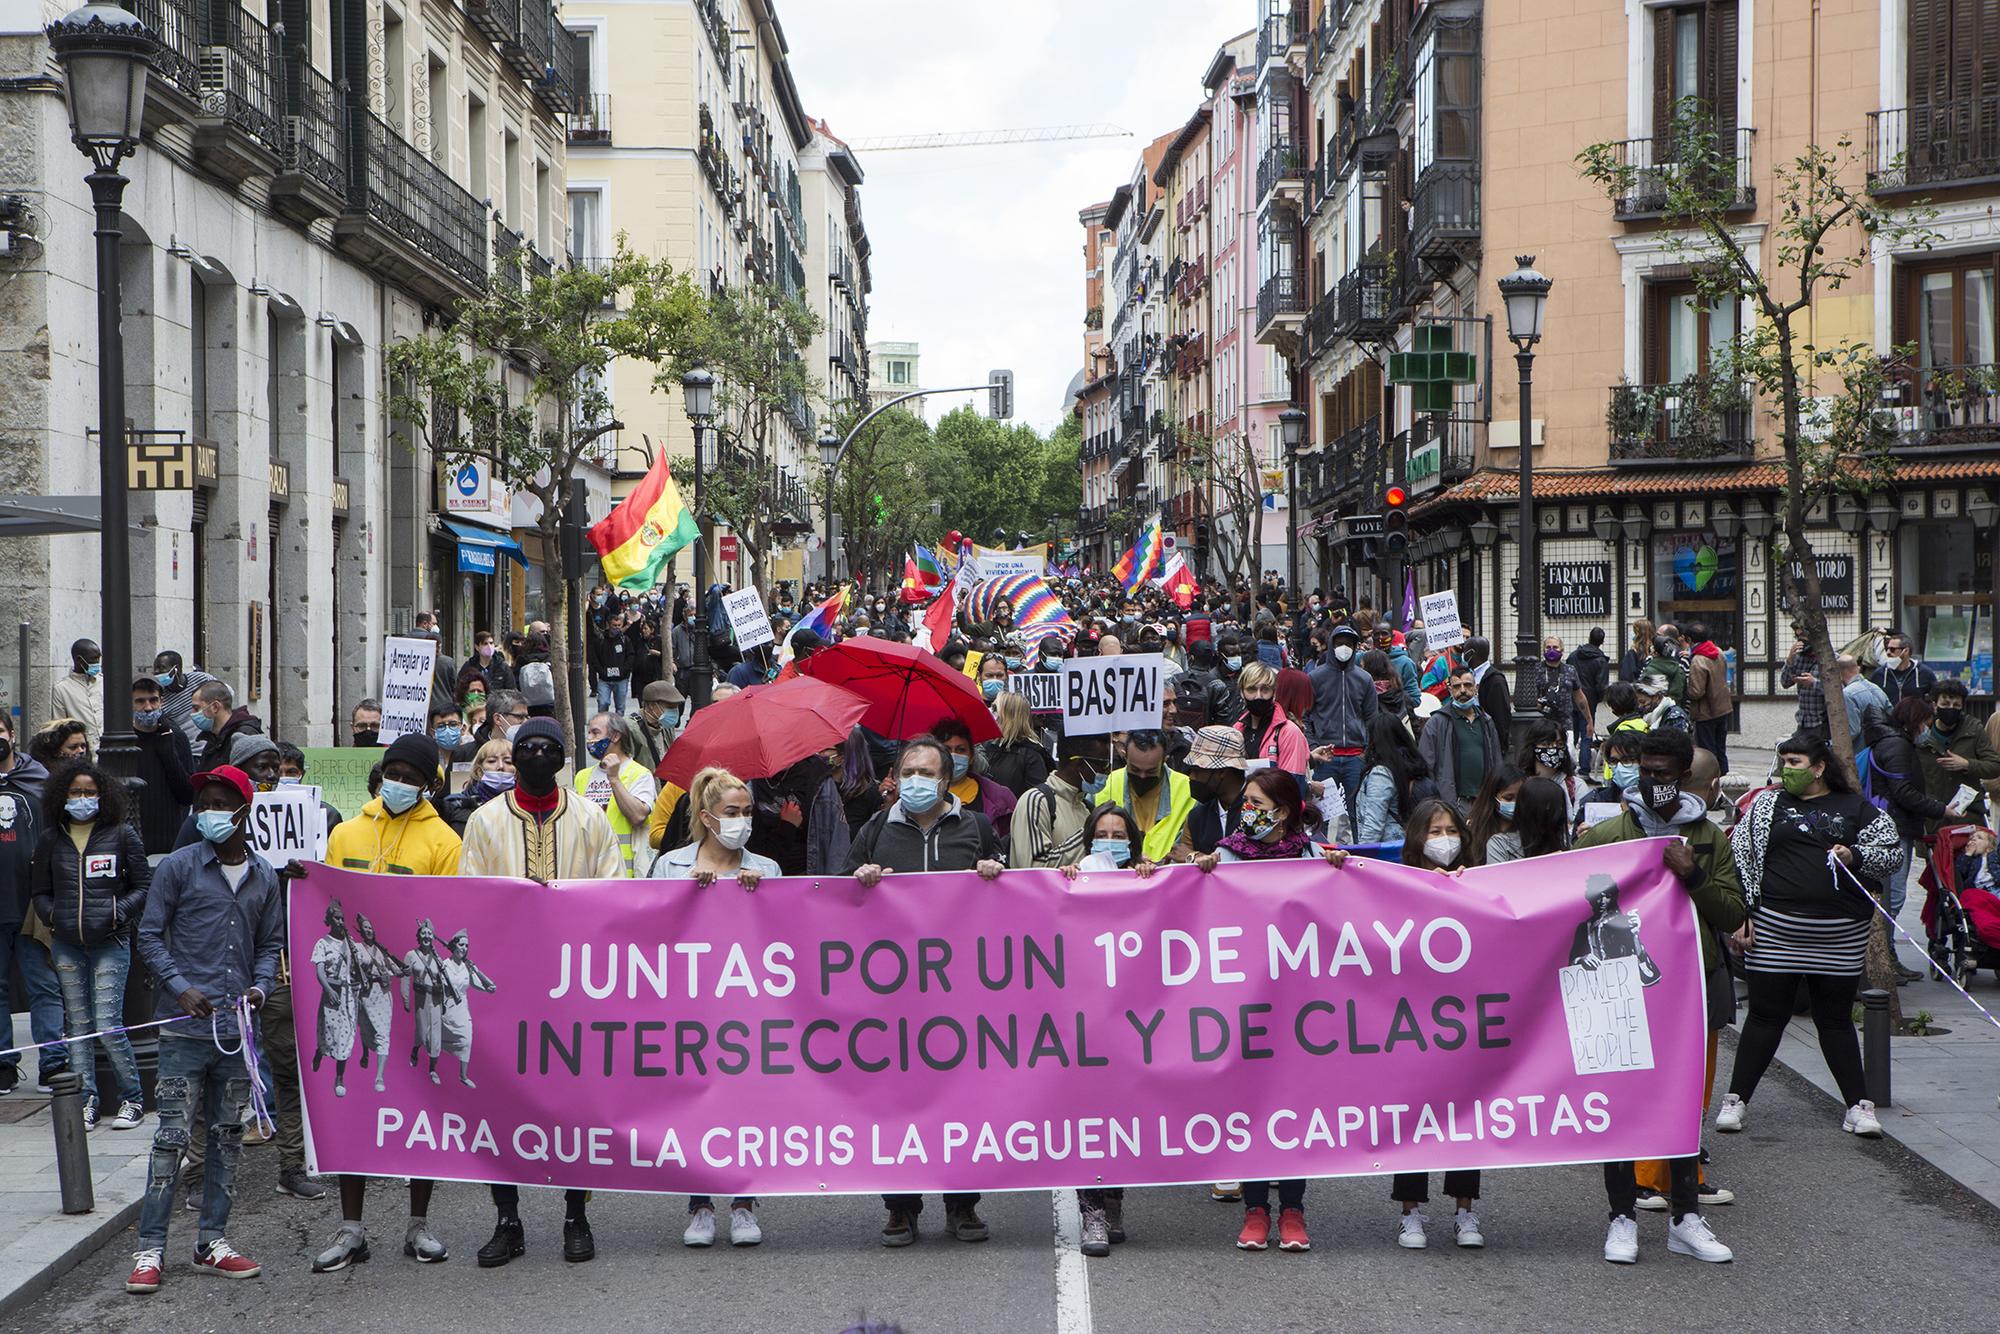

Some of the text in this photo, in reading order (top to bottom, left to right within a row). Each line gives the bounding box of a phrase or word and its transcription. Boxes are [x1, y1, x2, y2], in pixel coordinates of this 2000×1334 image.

[1549, 566, 1604, 585] FARMACIA
[1562, 585, 1590, 596] DE LA
[734, 609, 764, 628] documentos
[1427, 612, 1458, 628] documentos
[1549, 597, 1605, 615] FUENTECILLA
[389, 648, 430, 676] ¡Arreglar ya
[386, 679, 427, 702] documentos
[1014, 675, 1061, 708] BASTA!
[1068, 667, 1157, 717] BASTA!
[306, 776, 369, 792] ABORALES
[243, 803, 305, 851] ASTA!
[548, 942, 796, 1000] JUNTAS
[820, 937, 953, 996] POR
[977, 932, 1065, 991] UN
[1160, 925, 1247, 987] DE
[1266, 915, 1472, 981] MAYO
[1562, 961, 1632, 1004] POWER
[1569, 998, 1639, 1033] TO THE
[517, 992, 1509, 1077] INTERSECCIONAL Y DE CLASE
[1574, 1030, 1642, 1071] PEOPLE
[376, 1090, 1612, 1169] PARA QUE LA CRISIS LA PAGUEN LOS CAPITALISTAS
